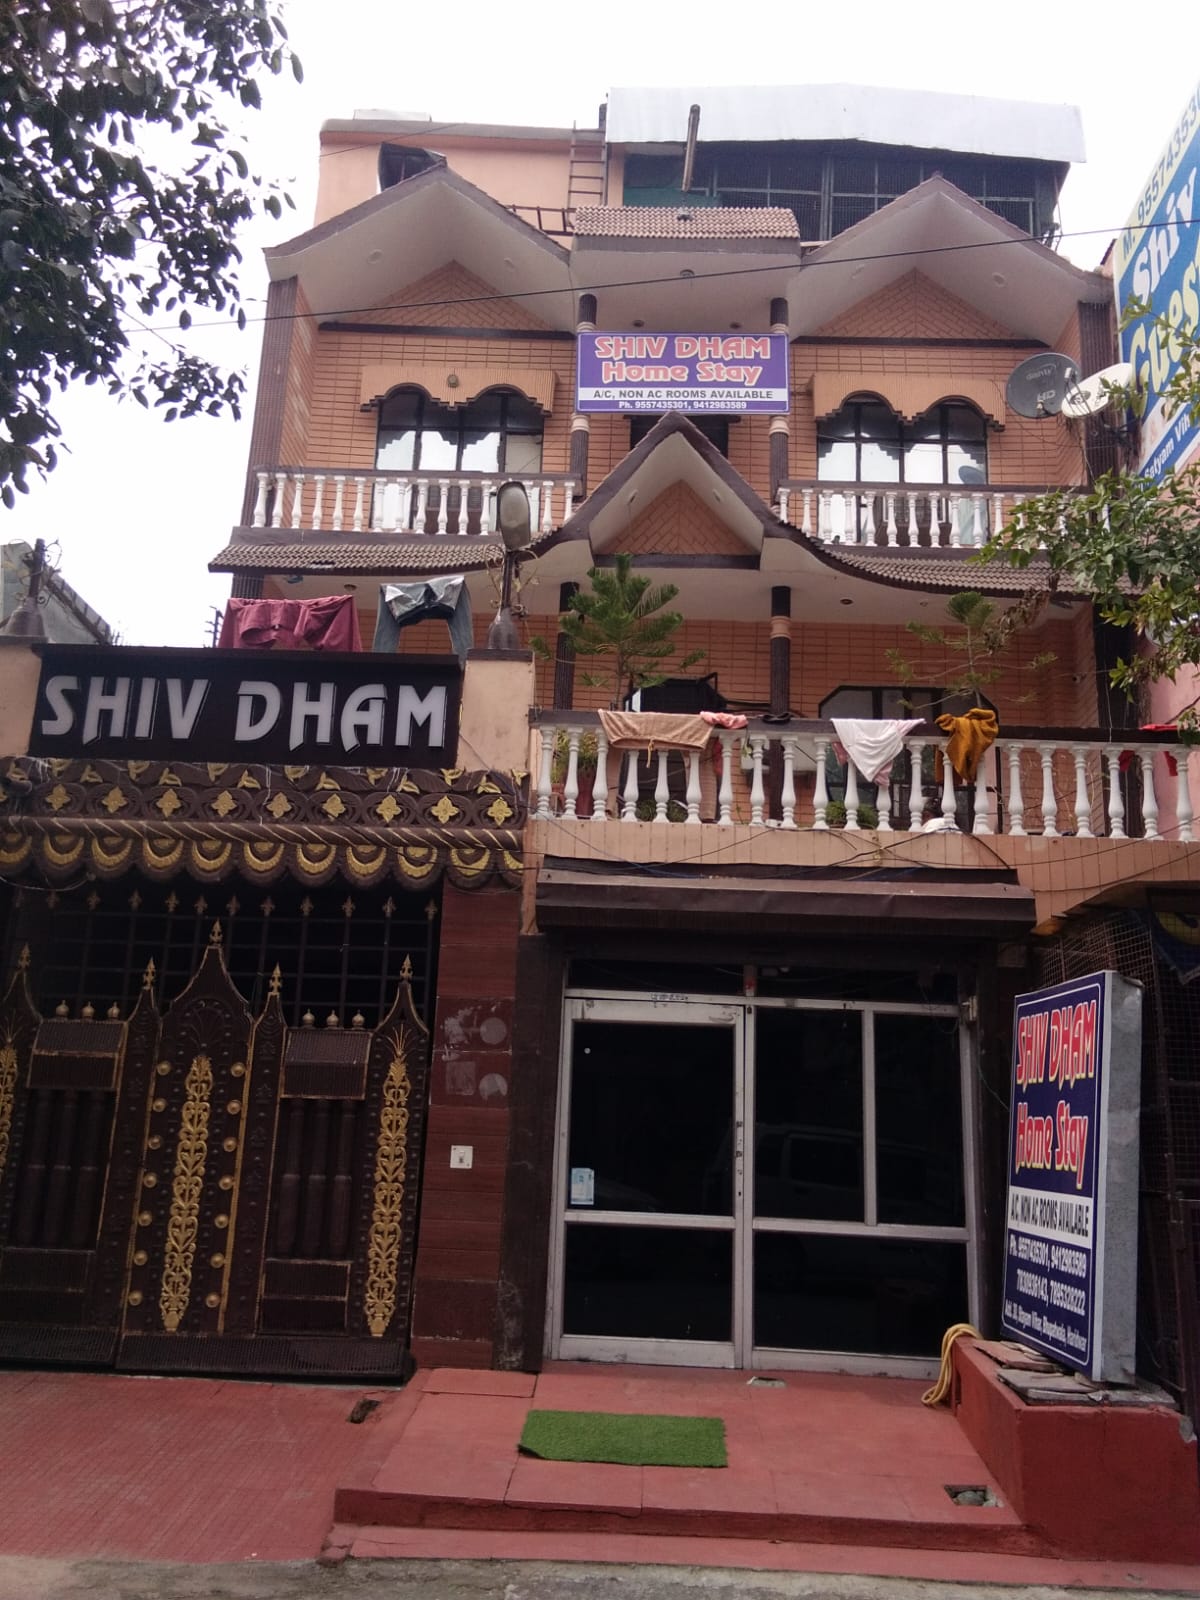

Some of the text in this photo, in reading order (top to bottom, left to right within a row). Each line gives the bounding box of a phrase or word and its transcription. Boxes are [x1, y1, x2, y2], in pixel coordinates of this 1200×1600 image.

[1133, 167, 1197, 313] Shiv
[595, 336, 771, 361] SHIV DHAM
[602, 361, 763, 386] Home Stay
[594, 390, 773, 399] A/C, NON AC ROOMS AVAILABLE
[619, 401, 747, 410] Ph. 9557435301, 9412983589
[1037, 390, 1056, 401] HD
[41, 675, 447, 753] SHIV DHAM
[1017, 1000, 1096, 1093] SHIV DHAM
[1015, 1100, 1088, 1189] Home Stay
[1020, 1195, 1031, 1224] NON
[1031, 1196, 1039, 1226] AC
[1039, 1198, 1058, 1230] ROOMS
[1058, 1200, 1089, 1237] AVAILABLE
